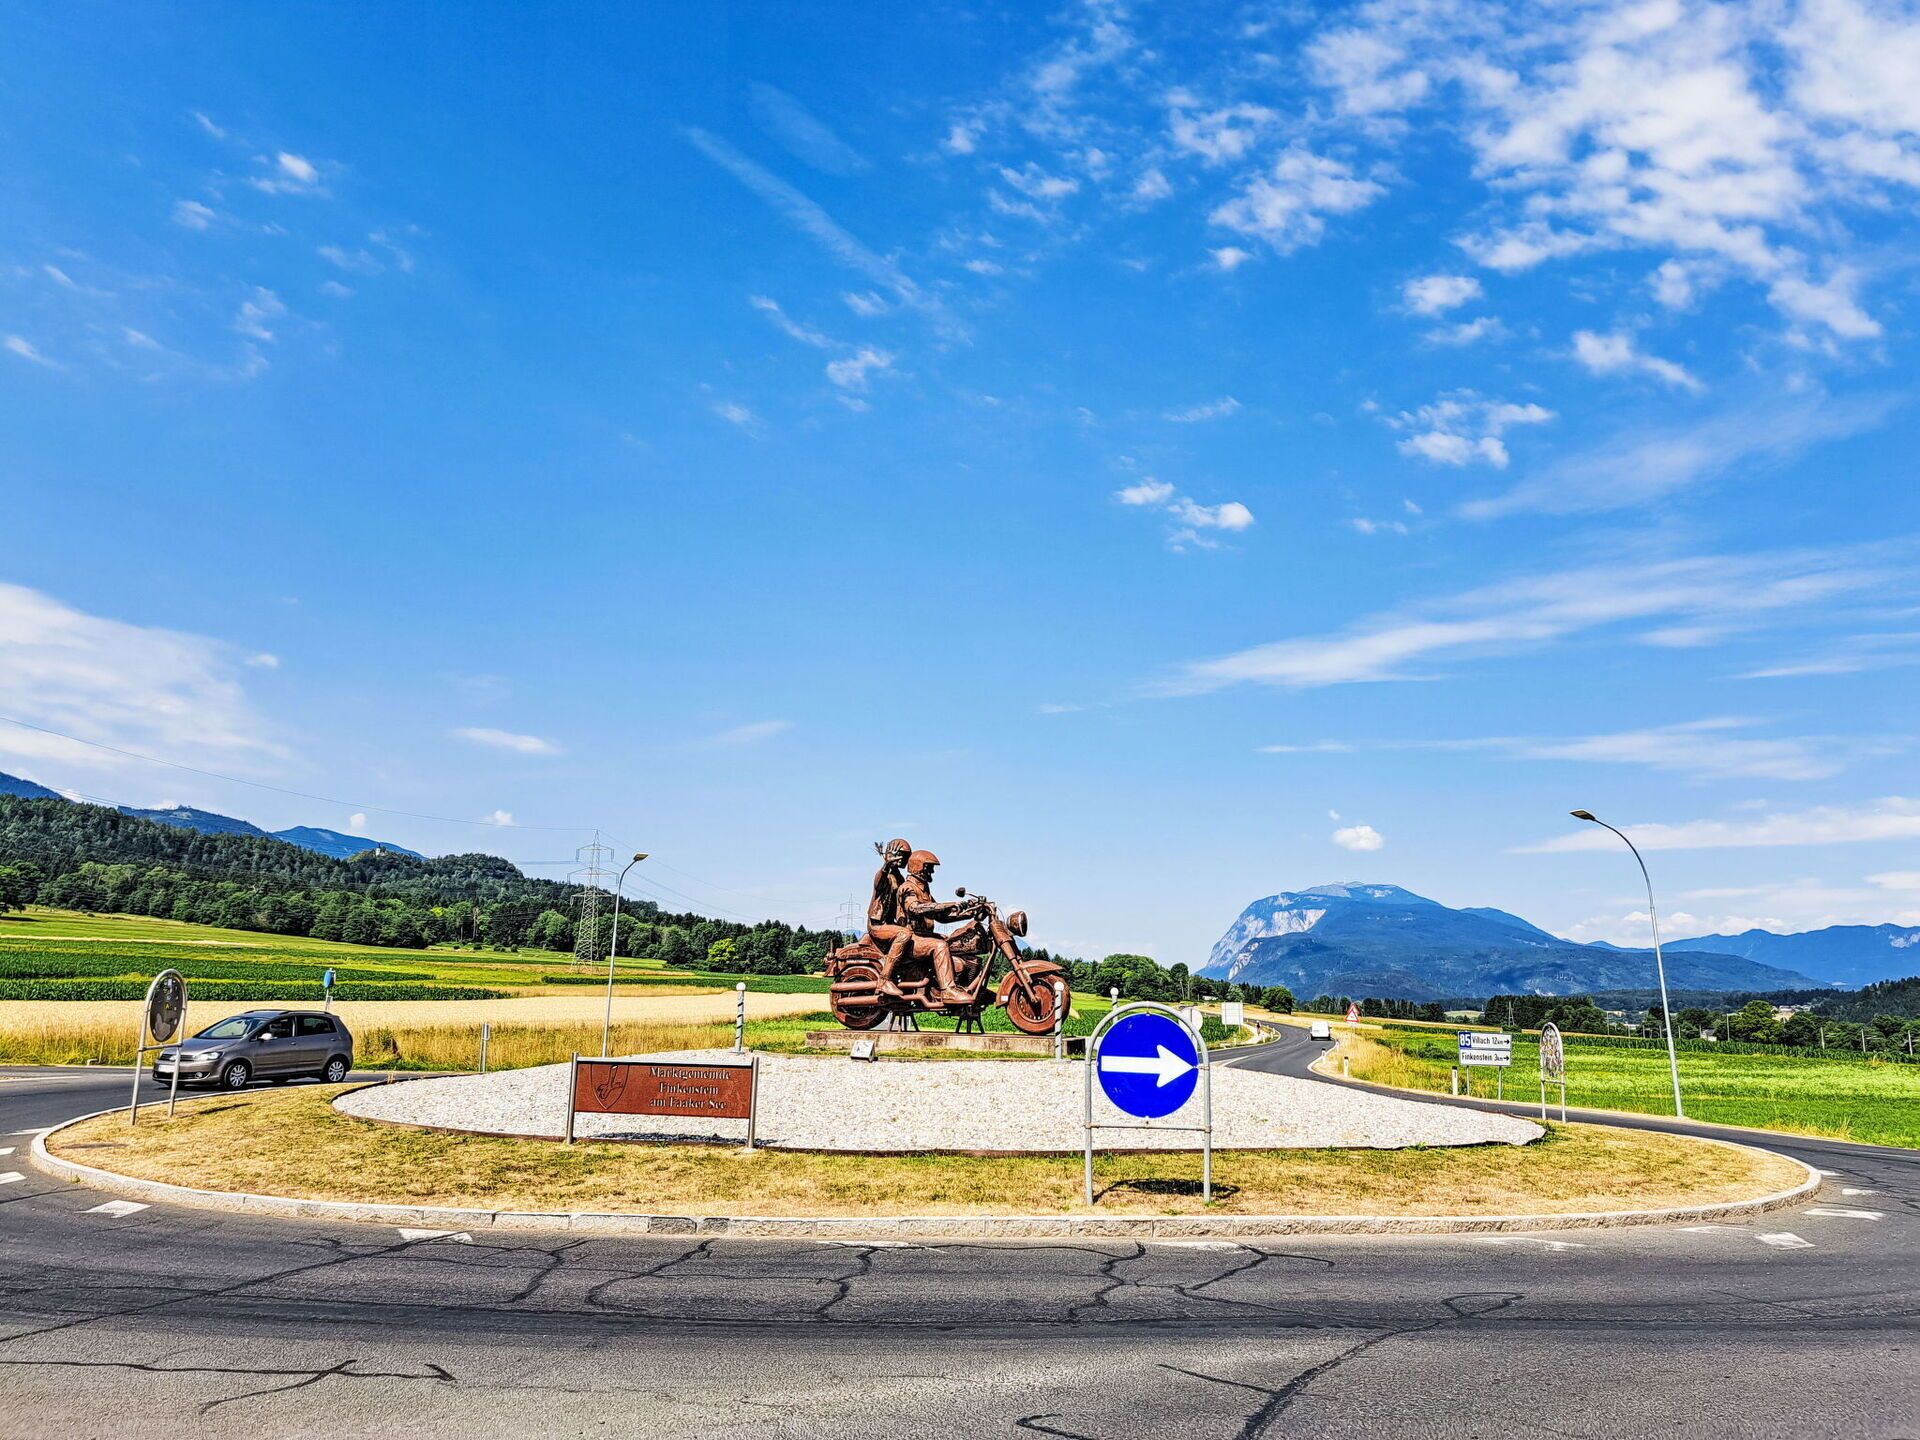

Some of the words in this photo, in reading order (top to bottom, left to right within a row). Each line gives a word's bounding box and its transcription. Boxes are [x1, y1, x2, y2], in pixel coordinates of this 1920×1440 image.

[1460, 1033, 1471, 1047] 85
[1472, 1036, 1490, 1045] Villach
[1461, 1052, 1492, 1061] Finkenstein
[649, 1067, 731, 1080] Marktgemeinde
[659, 1082, 719, 1095] Finkenstein
[649, 1097, 666, 1108] am
[669, 1097, 706, 1109] Faaker
[708, 1098, 728, 1110] See
